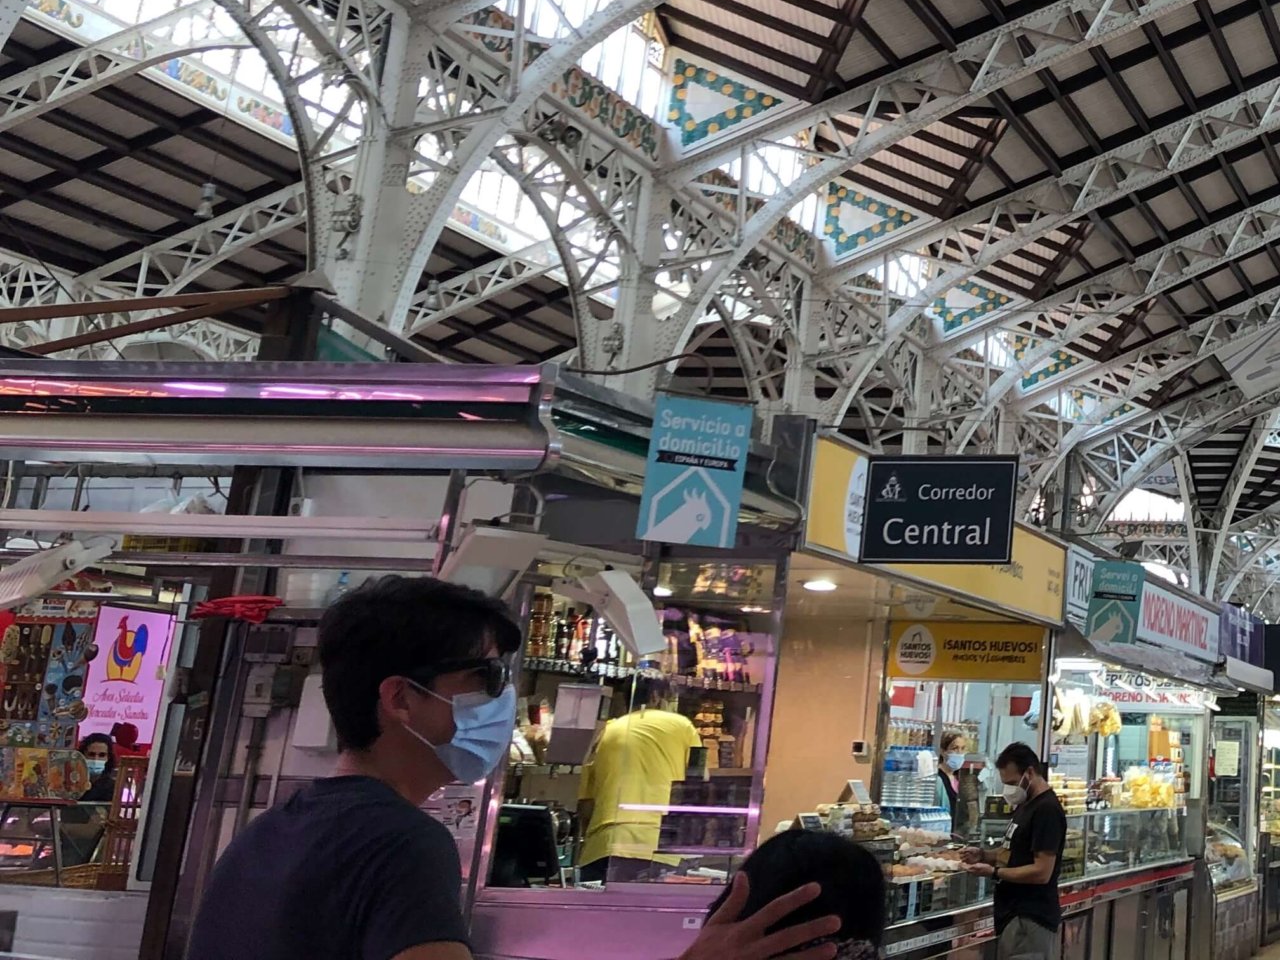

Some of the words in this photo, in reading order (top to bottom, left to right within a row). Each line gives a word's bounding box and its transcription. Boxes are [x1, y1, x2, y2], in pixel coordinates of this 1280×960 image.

[661, 409, 731, 435] Servicio
[659, 432, 740, 458] domicilio
[918, 484, 995, 500] Corredor
[882, 517, 991, 545] Central
[1143, 590, 1175, 638] MORENO
[1175, 603, 1209, 650] MARTINEZ
[943, 638, 988, 651] ¡SANTOS
[989, 641, 1038, 653] HUEVOS!
